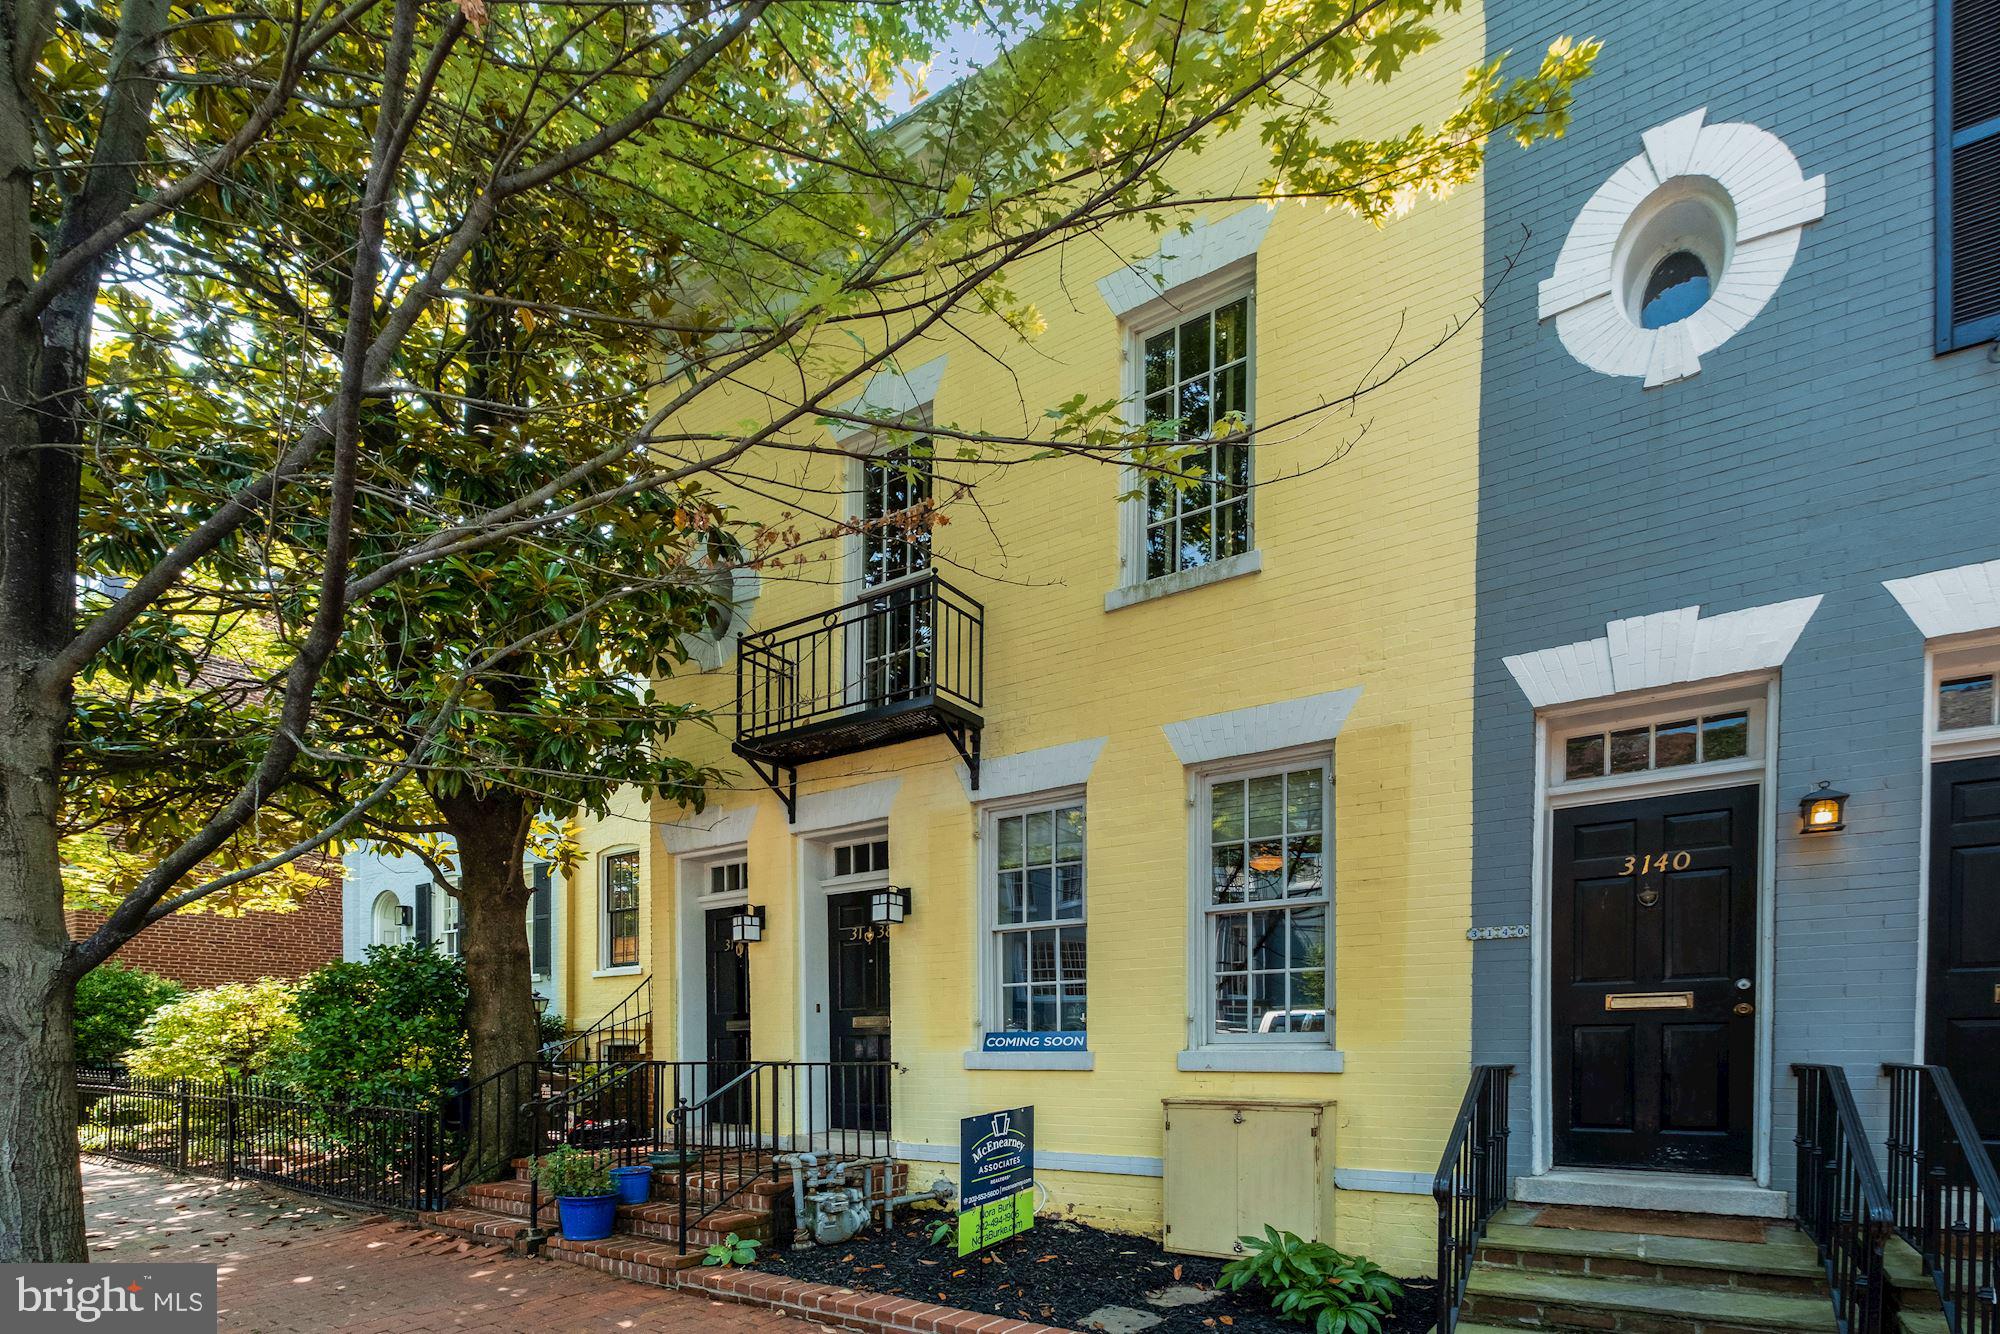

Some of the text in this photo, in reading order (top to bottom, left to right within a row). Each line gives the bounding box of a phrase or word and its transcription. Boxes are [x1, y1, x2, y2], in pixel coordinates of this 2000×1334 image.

[1618, 851, 1691, 876] 3140
[1471, 927, 1524, 938] 3140
[986, 1036, 1084, 1047] COMING SOON
[972, 1138, 1025, 1164] McEnearney
[978, 1156, 1021, 1174] ASSOCIATES
[997, 1200, 1015, 1213] Burk
